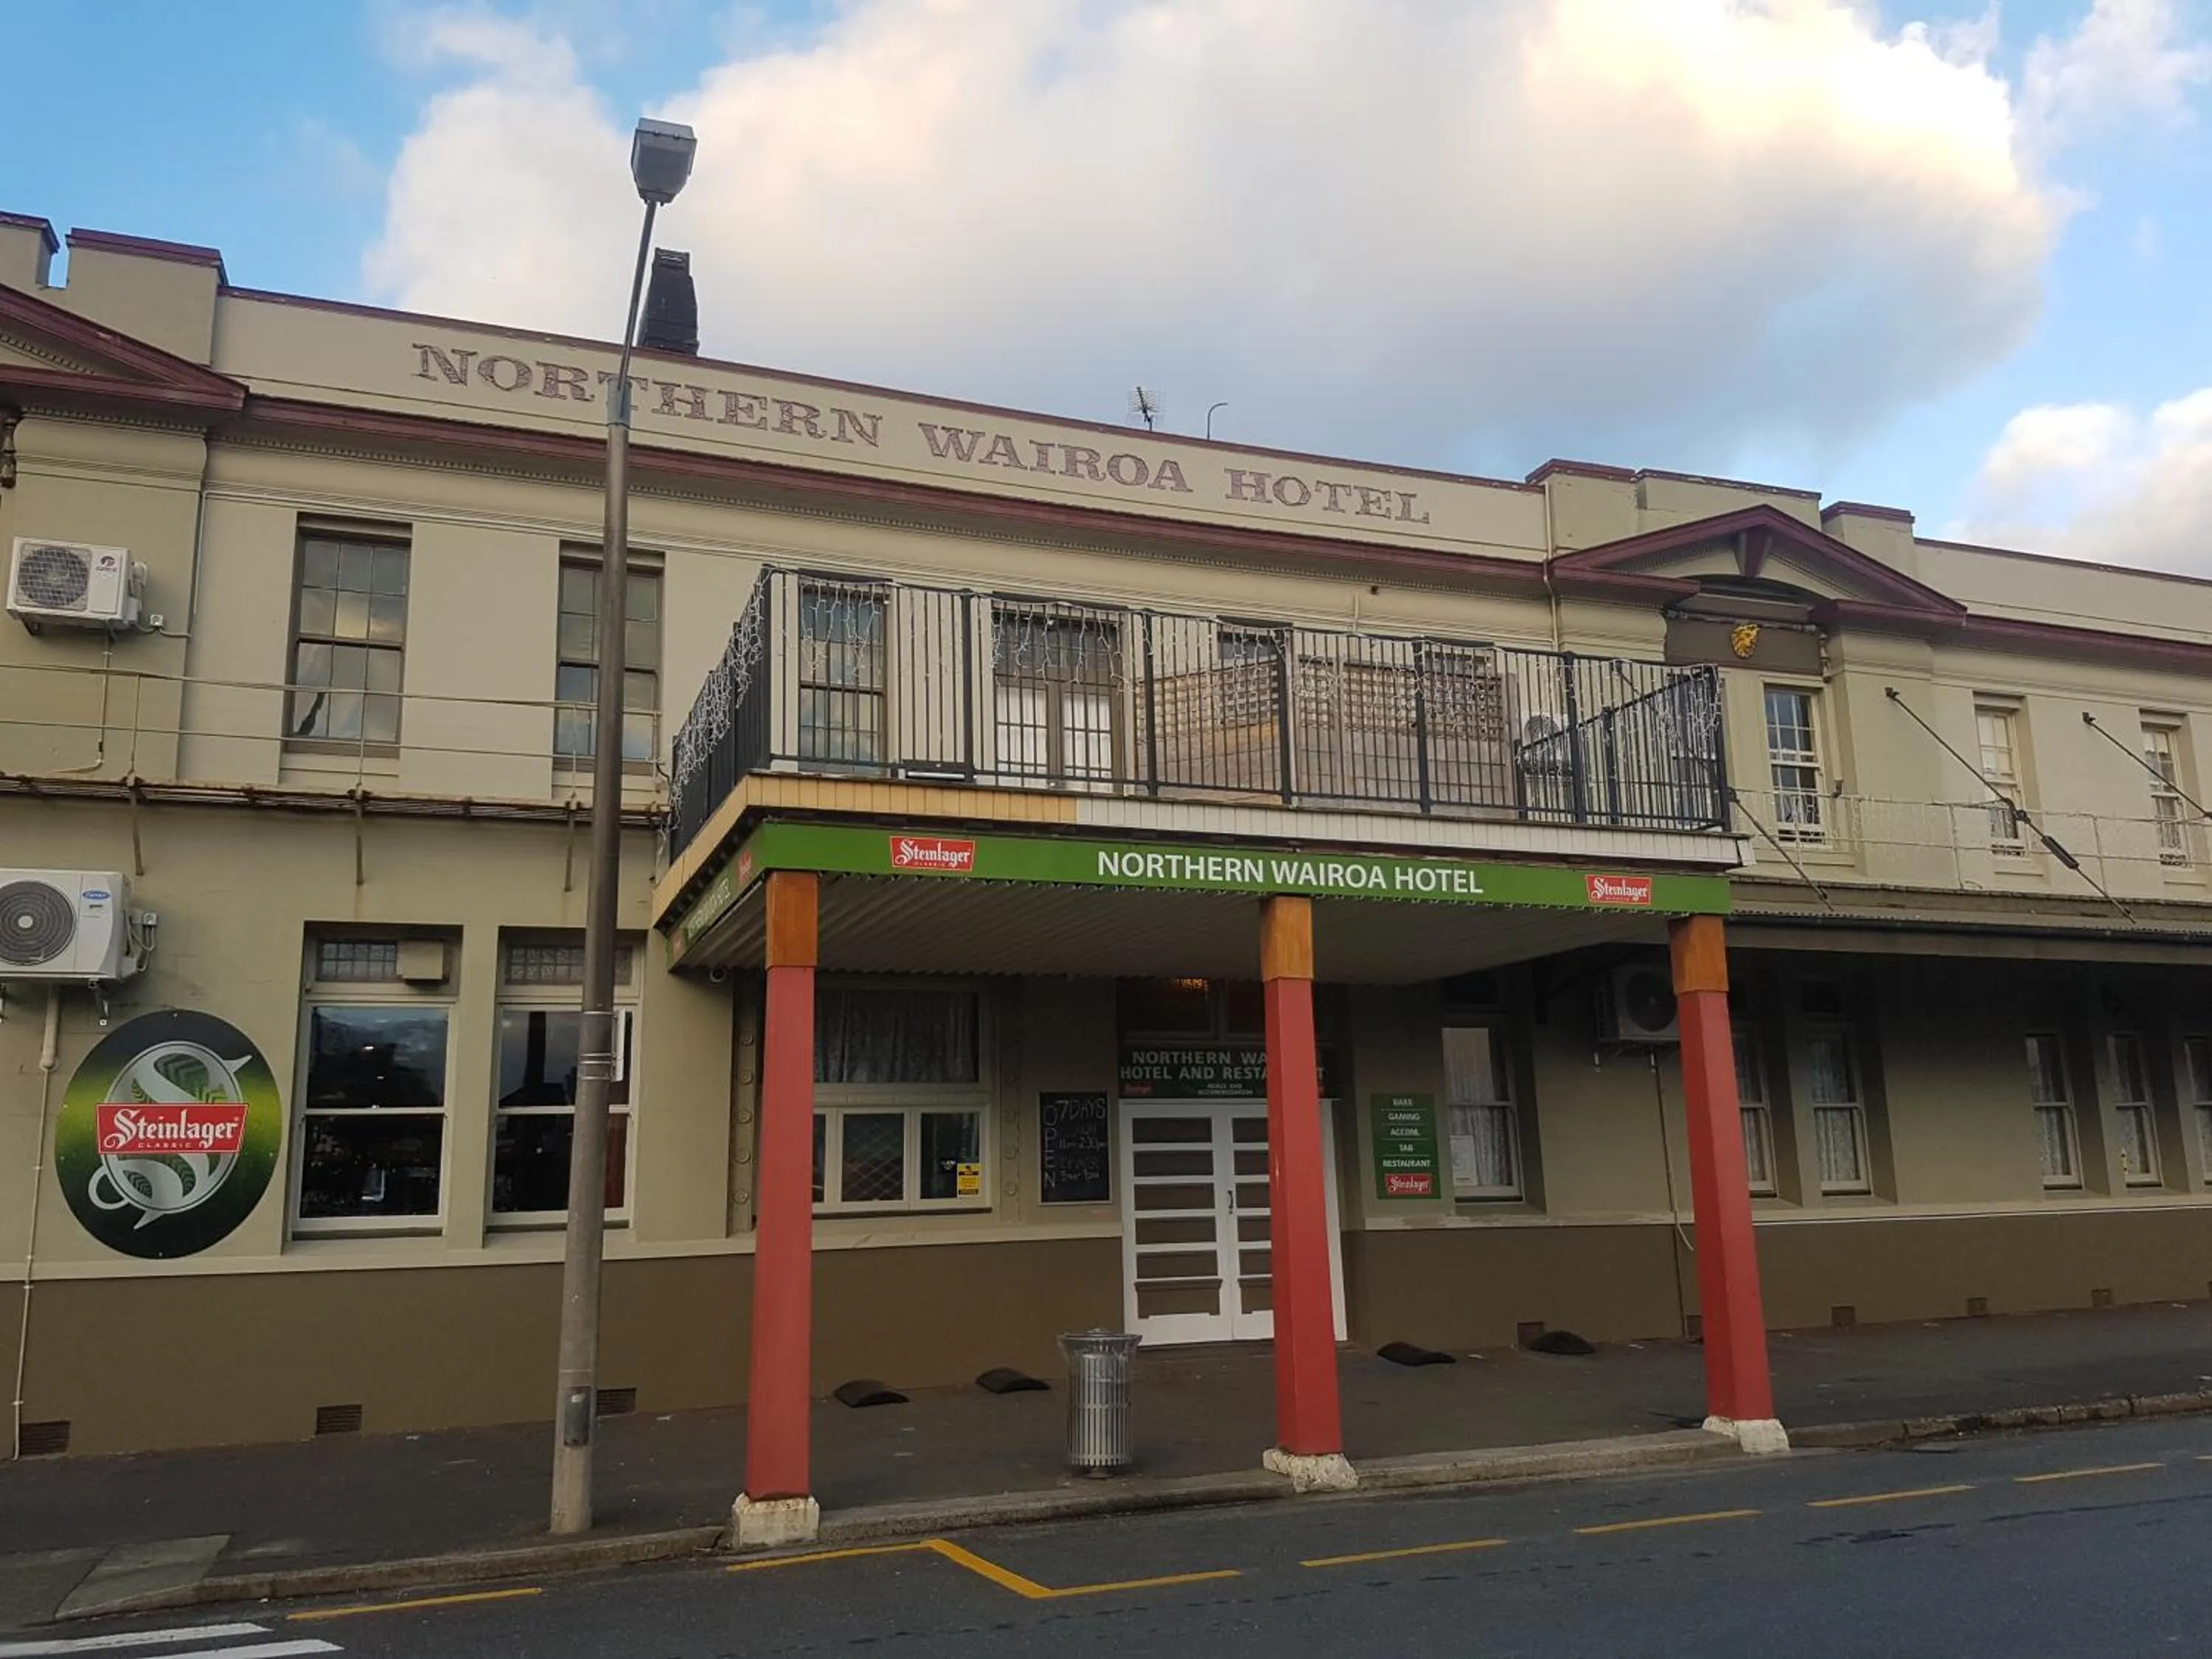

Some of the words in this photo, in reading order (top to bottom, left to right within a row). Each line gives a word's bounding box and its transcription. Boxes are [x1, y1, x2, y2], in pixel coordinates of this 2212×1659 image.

[919, 422, 1192, 492] WAIROA
[1225, 468, 1429, 524] HOTEL
[894, 839, 971, 868] Steinlager
[1098, 851, 1264, 883] NORTHERN
[1271, 860, 1386, 889] WAIROA
[1395, 866, 1484, 894] HOTEL
[1590, 877, 1647, 902] Steinlager
[1133, 1051, 1231, 1064] NORTHERN
[1121, 1066, 1172, 1080] HOTEL
[1180, 1066, 1214, 1080] AND
[104, 1108, 240, 1149] Steinlager
[1388, 1113, 1421, 1121] GAMING
[1383, 1160, 1430, 1168] RESTAURANT
